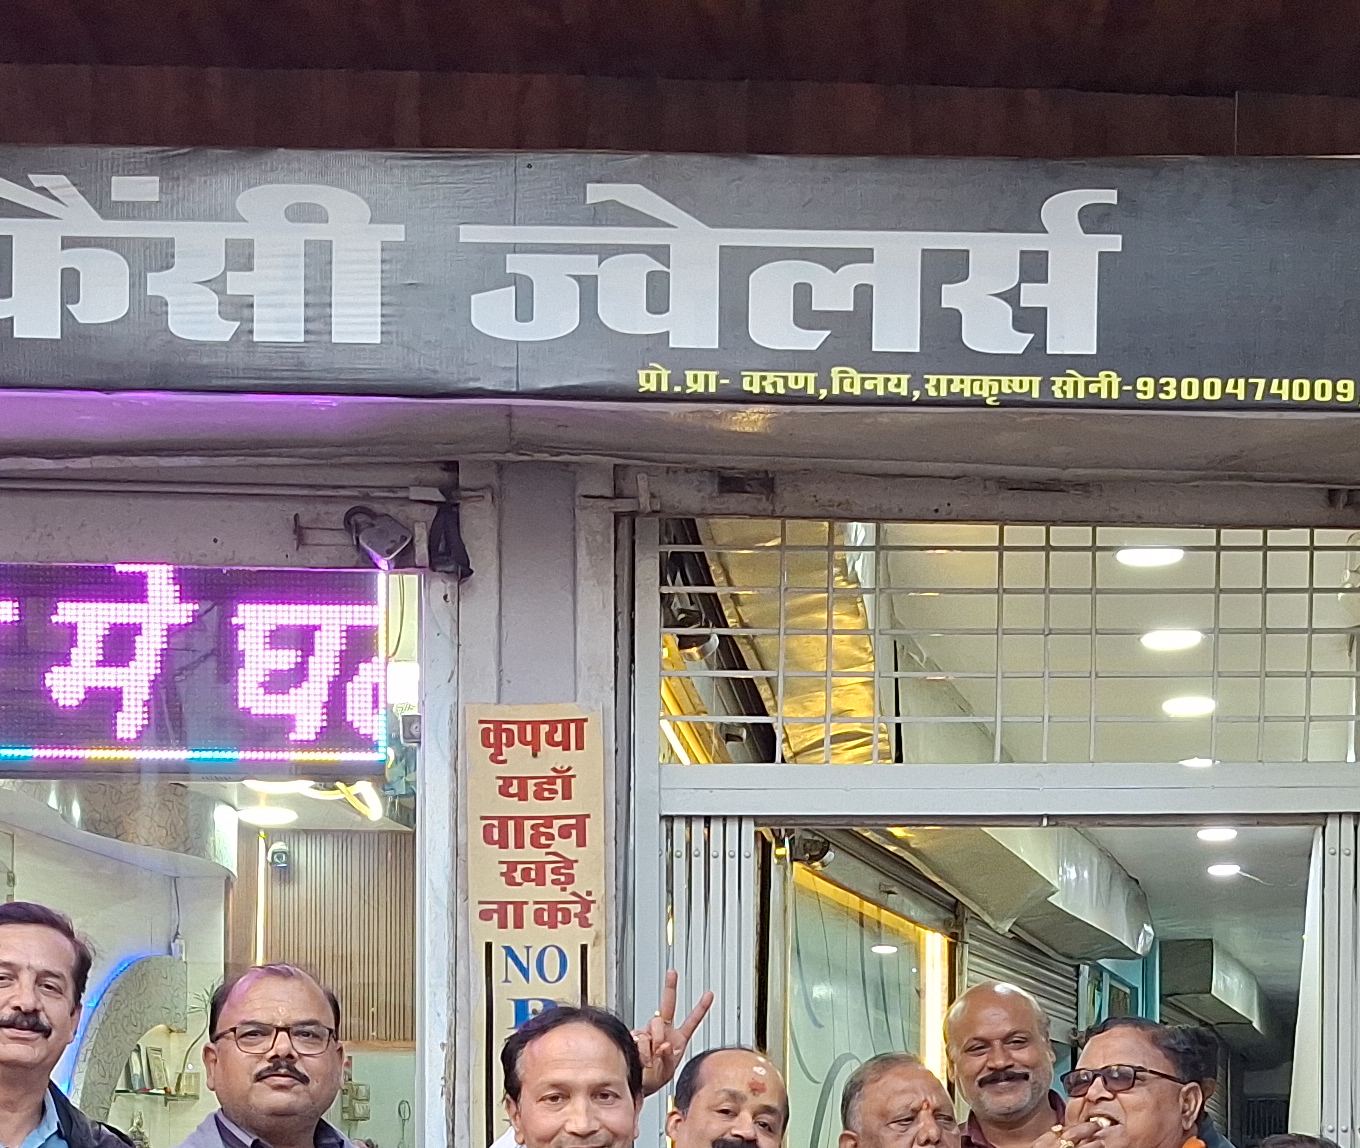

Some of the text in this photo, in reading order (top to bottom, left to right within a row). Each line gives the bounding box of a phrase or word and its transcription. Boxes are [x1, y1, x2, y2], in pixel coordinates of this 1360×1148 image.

[463, 181, 1122, 357] ज्वेलर्स
[478, 717, 589, 765] कृपया
[495, 765, 577, 802] यहाँ
[479, 813, 591, 850] वाहन
[498, 851, 578, 892] खड़े
[477, 890, 597, 930] ना करें
[501, 944, 569, 985] NO
